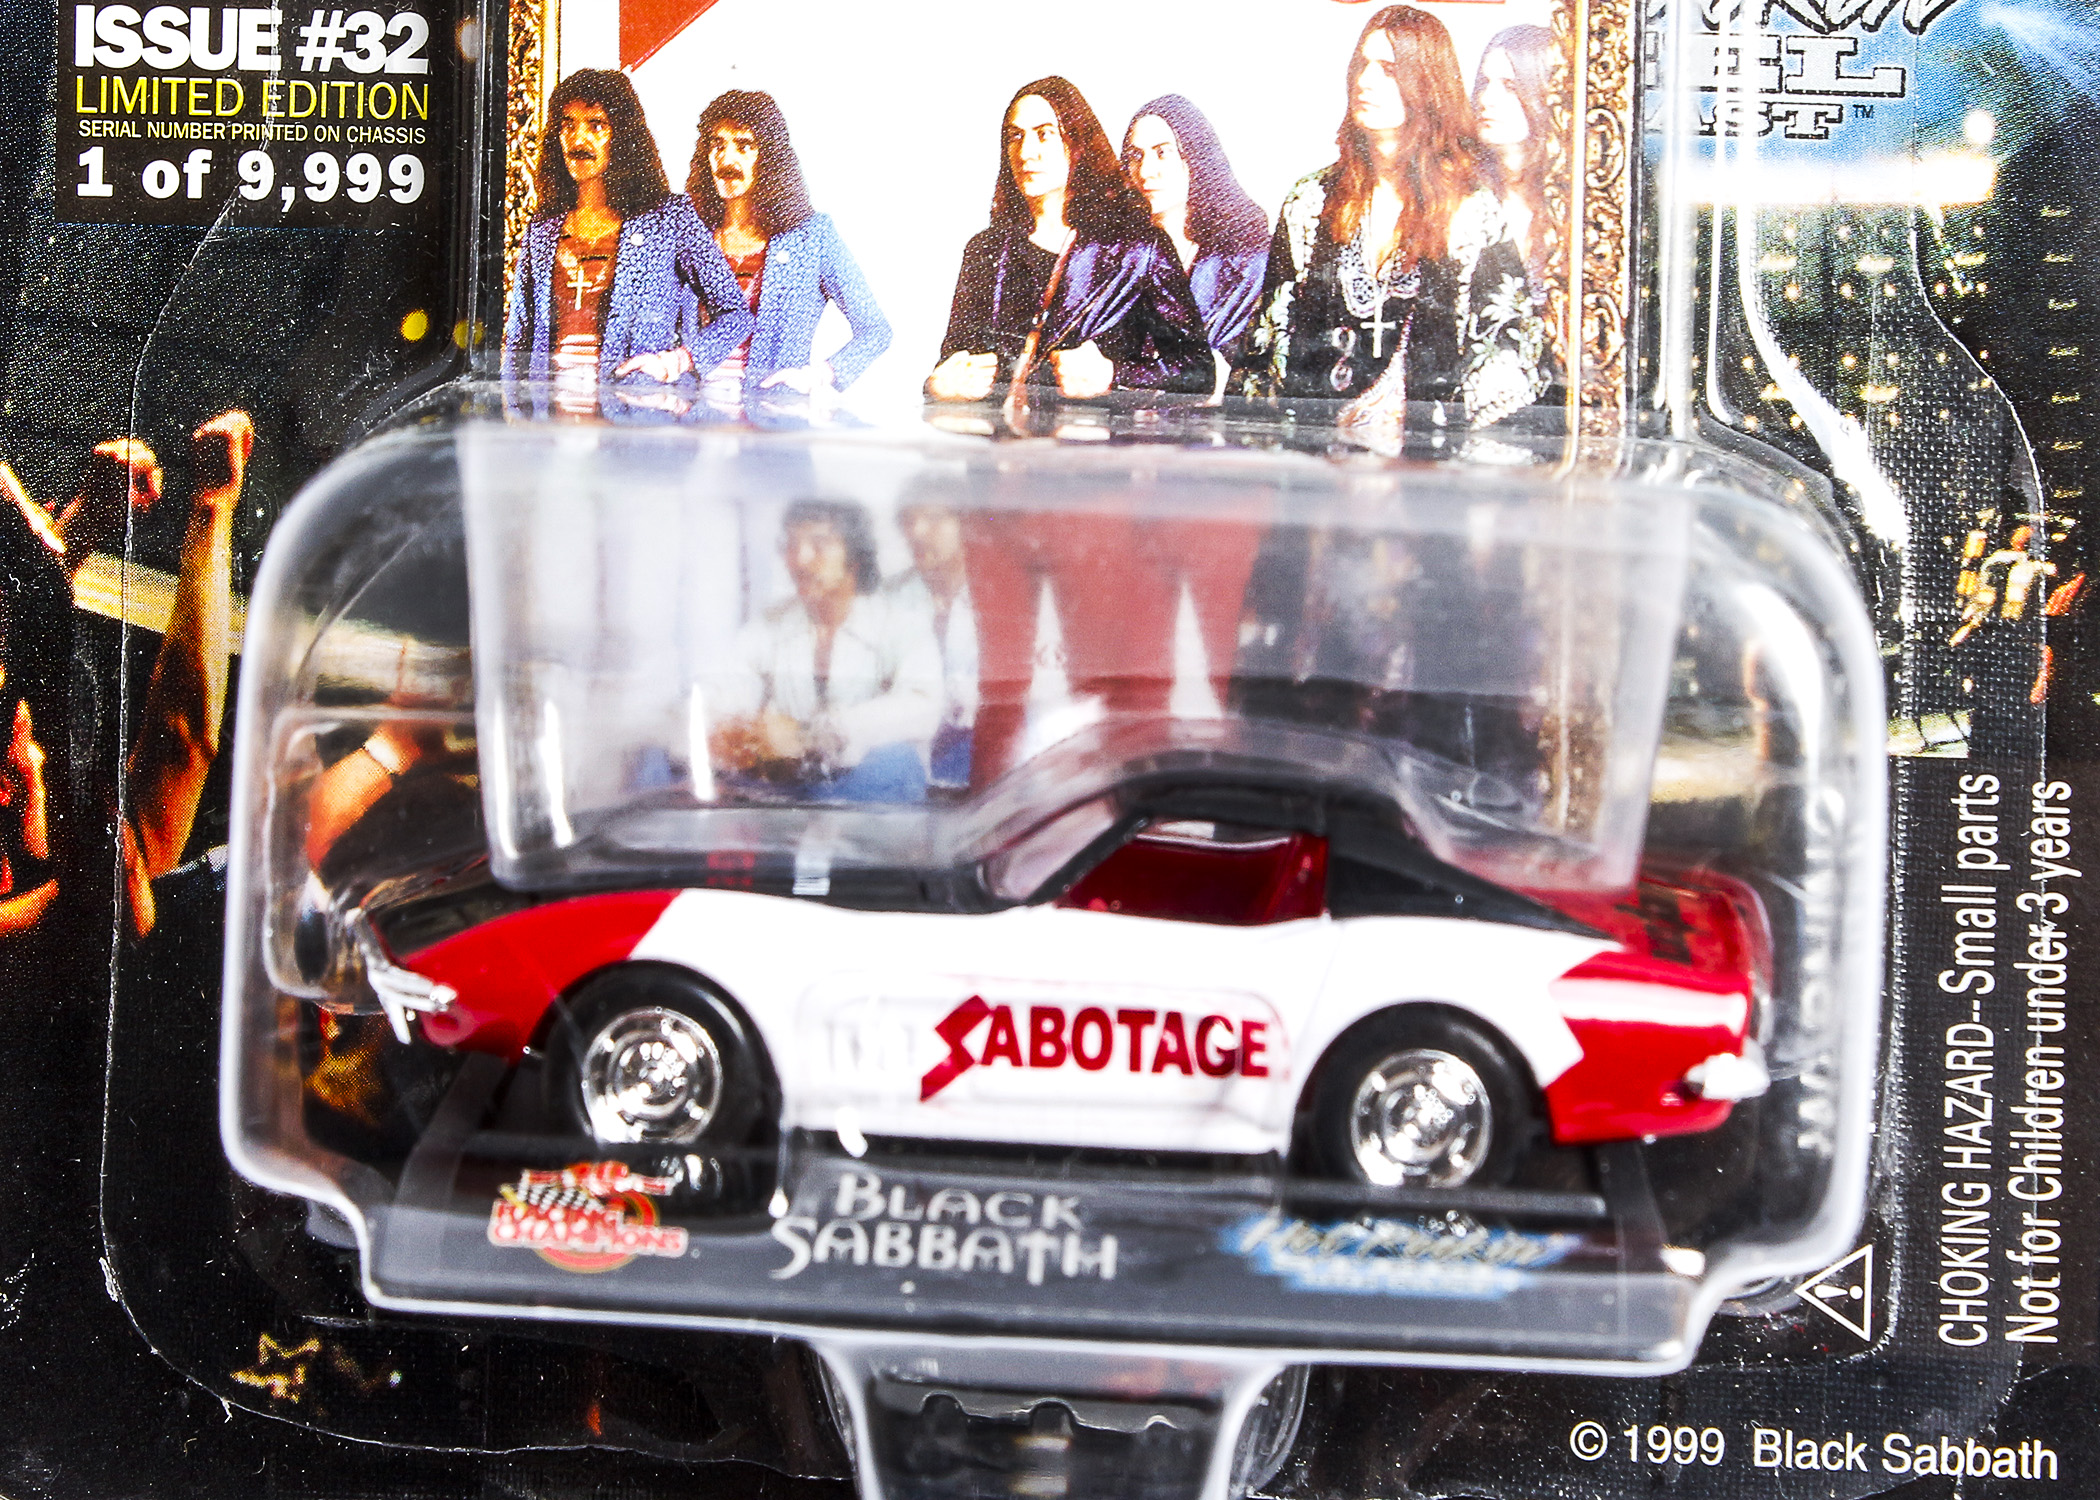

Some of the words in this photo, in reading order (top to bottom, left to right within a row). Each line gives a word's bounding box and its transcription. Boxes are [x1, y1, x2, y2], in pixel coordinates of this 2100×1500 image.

[74, 4, 283, 71] ISSUE
[295, 9, 430, 74] #32
[75, 75, 245, 117] LIMITED
[261, 79, 429, 121] EDITION
[77, 119, 142, 139] SERIAL
[146, 121, 226, 141] NUMBER
[230, 122, 309, 143] PRINTED
[313, 124, 341, 143] ON
[346, 125, 427, 145] CHASSIS
[76, 145, 114, 198] 1
[140, 148, 213, 199] of
[236, 148, 426, 213] 9,999
[1950, 773, 2011, 871] parts
[2030, 780, 2083, 881] years
[2015, 891, 2070, 915] 3
[2013, 923, 2068, 1033] under
[918, 994, 1271, 1102] SABOTAGE
[2007, 1045, 2066, 1202] Children
[833, 1171, 1084, 1231] BLACK
[767, 1214, 1120, 1287] SABBATH
[1937, 1181, 1993, 1347] CHOKING
[2005, 1211, 2062, 1265] for
[2004, 1274, 2061, 1344] Not
[1623, 1424, 1725, 1466] 1999
[1752, 1427, 1869, 1473] Black
[1881, 1433, 2059, 1481] Sabbath
